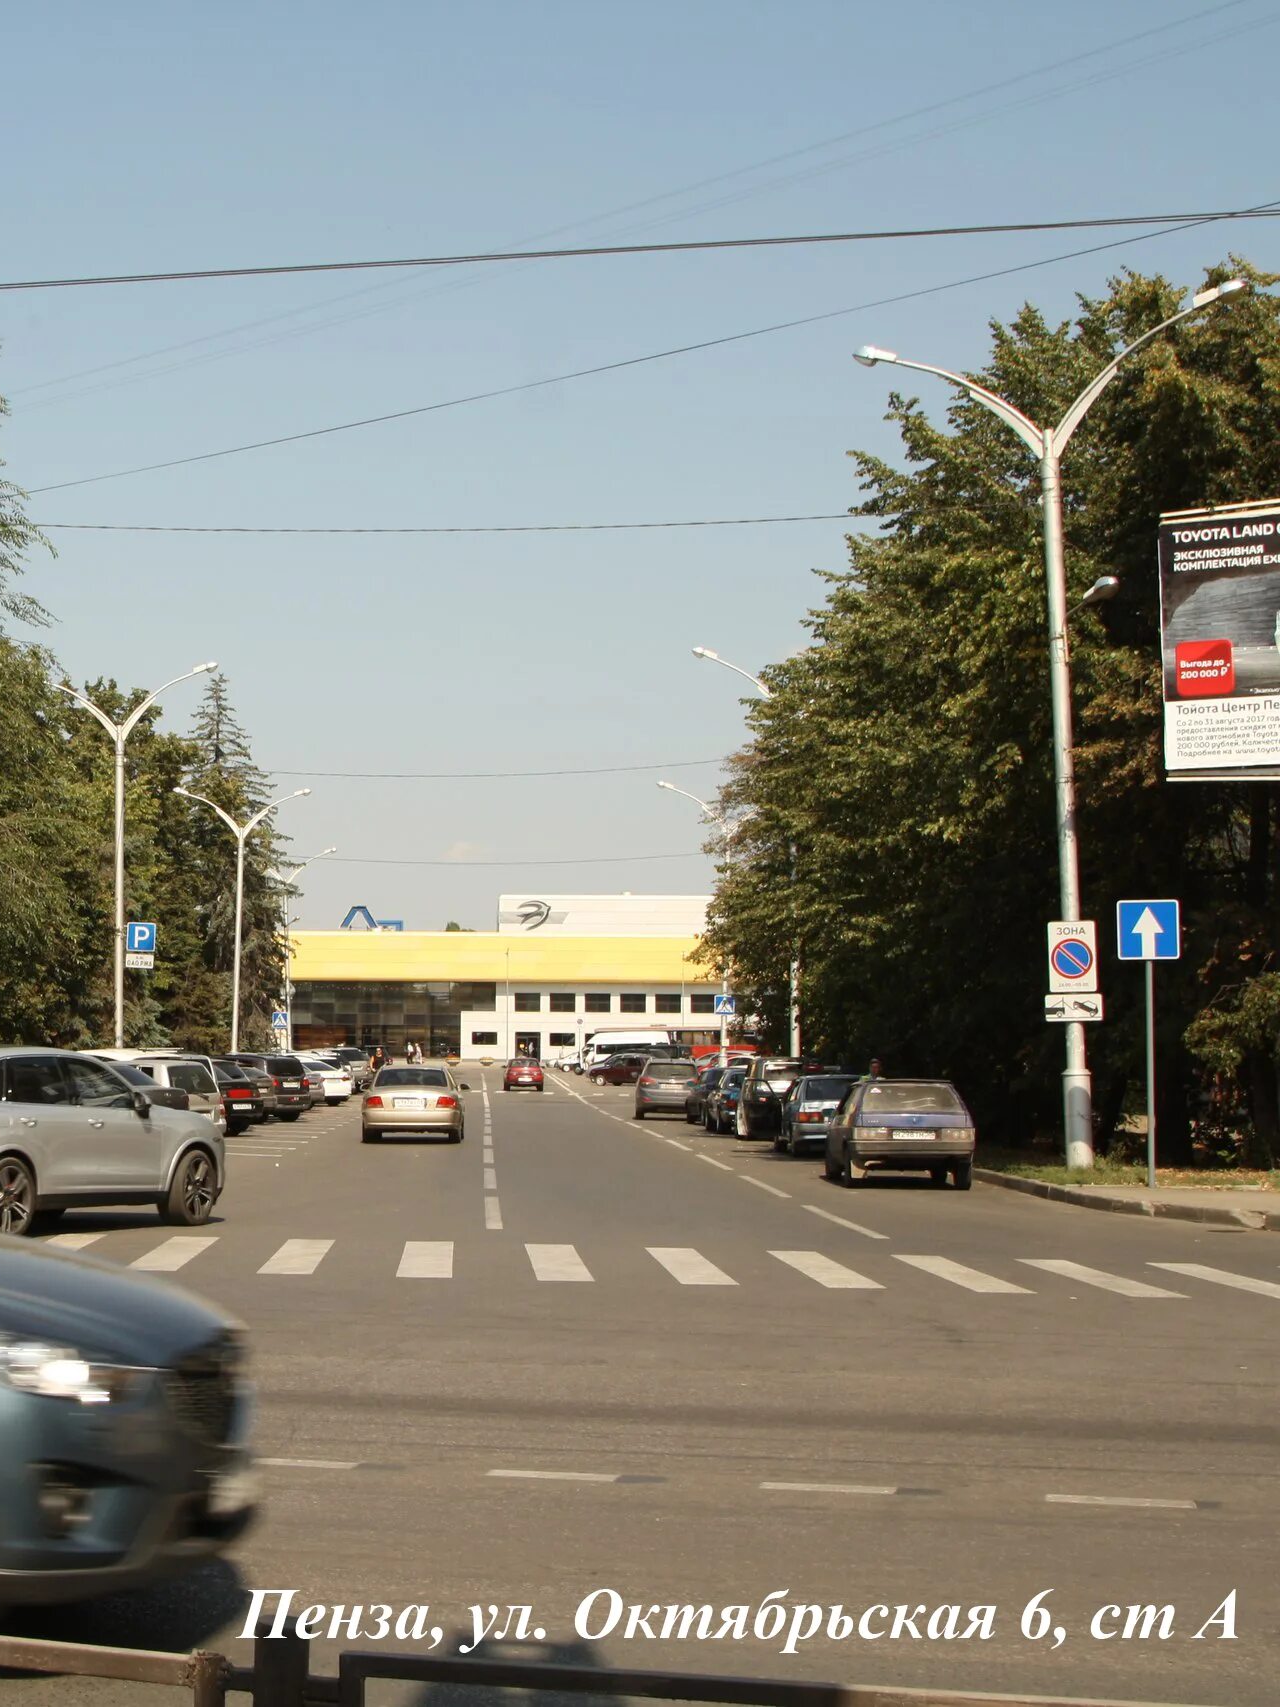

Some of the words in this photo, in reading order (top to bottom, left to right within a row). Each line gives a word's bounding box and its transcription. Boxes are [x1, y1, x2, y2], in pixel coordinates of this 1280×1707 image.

[1172, 527, 1230, 544] TOYOTA
[1232, 523, 1274, 539] LAND
[1173, 544, 1264, 562] ЭКСКЛЮЗИВНАЯ
[1173, 555, 1261, 573] КОМПЛЕКТАЦИЯ
[1180, 660, 1211, 668] Выгода
[1181, 671, 1198, 679] 200
[1200, 669, 1218, 677] 000
[1176, 705, 1219, 715] Тойота
[1222, 703, 1260, 713] Центр
[1056, 927, 1086, 935] ЗОНА
